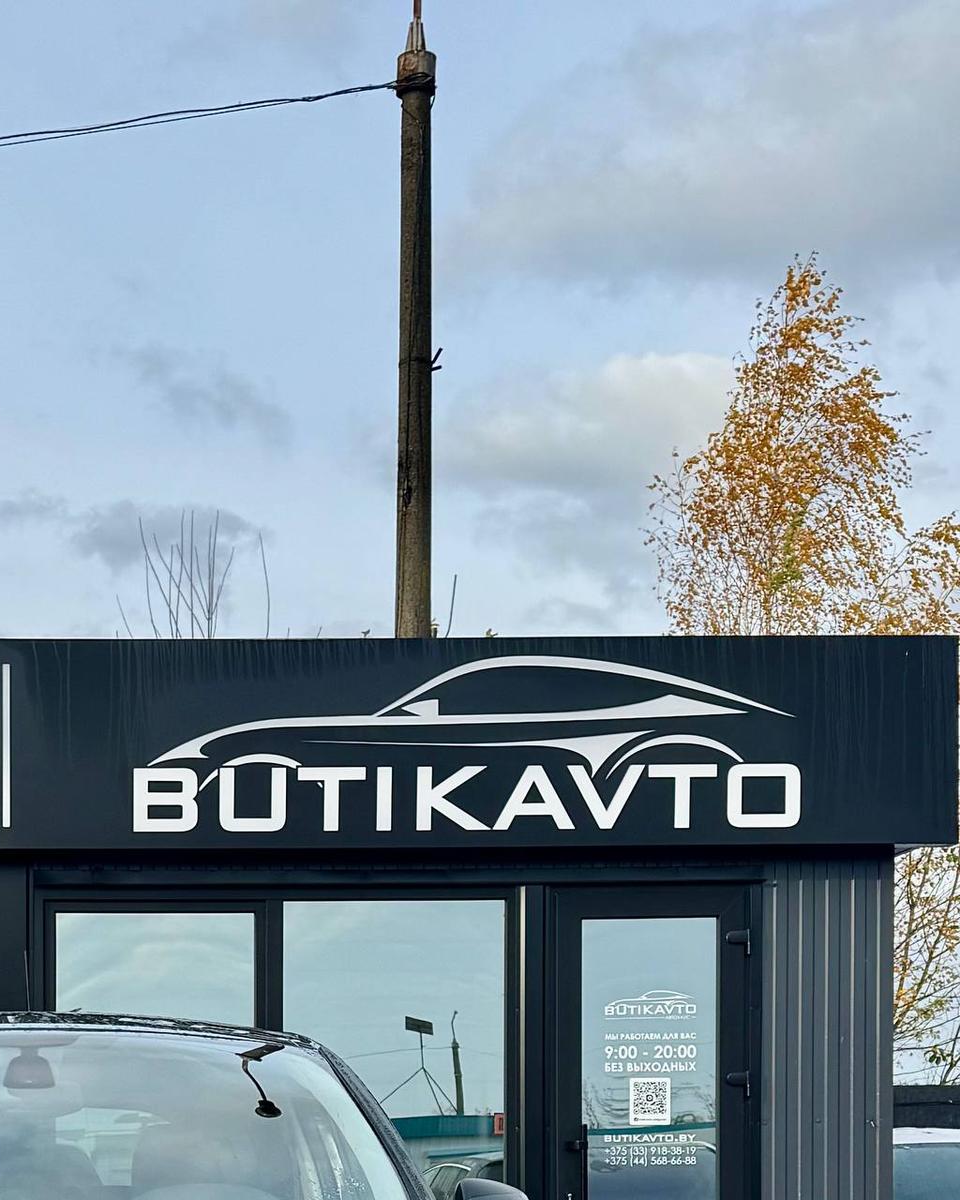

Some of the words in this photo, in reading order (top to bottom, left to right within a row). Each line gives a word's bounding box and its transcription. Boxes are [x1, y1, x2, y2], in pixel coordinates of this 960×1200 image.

[132, 763, 803, 833] BUTIKAVTO
[604, 1004, 697, 1016] BUTIKAVTO
[662, 1033, 679, 1041] ДЛЯ
[604, 1046, 638, 1060] 9:00
[654, 1045, 697, 1059] 20:00
[604, 1062, 624, 1073] БЕЗ
[626, 1062, 697, 1073] ВЫХОДНЫХ
[604, 1133, 697, 1143] BUTIKAVTO.BY
[604, 1147, 627, 1156] +375
[630, 1146, 648, 1157] (33)
[650, 1147, 697, 1156] 918-38-19
[604, 1156, 627, 1166] +375
[630, 1156, 648, 1167] (44)
[650, 1156, 697, 1166] 568-66-88
